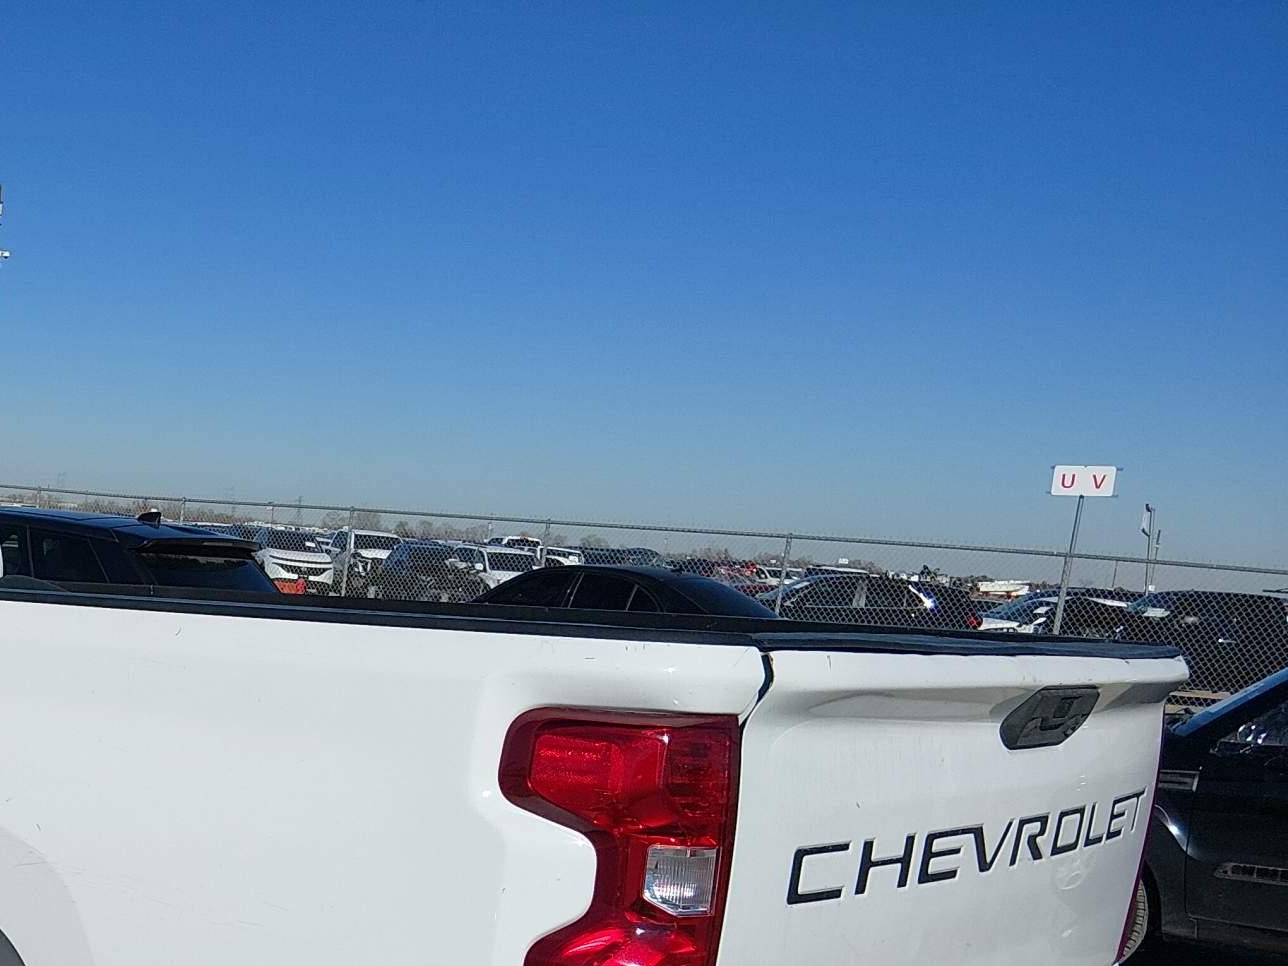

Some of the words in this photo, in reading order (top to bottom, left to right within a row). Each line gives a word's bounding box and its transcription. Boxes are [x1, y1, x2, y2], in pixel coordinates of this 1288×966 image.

[1061, 473, 1076, 488] U
[1092, 474, 1106, 489] V
[786, 790, 1146, 904] CHEVROLET
